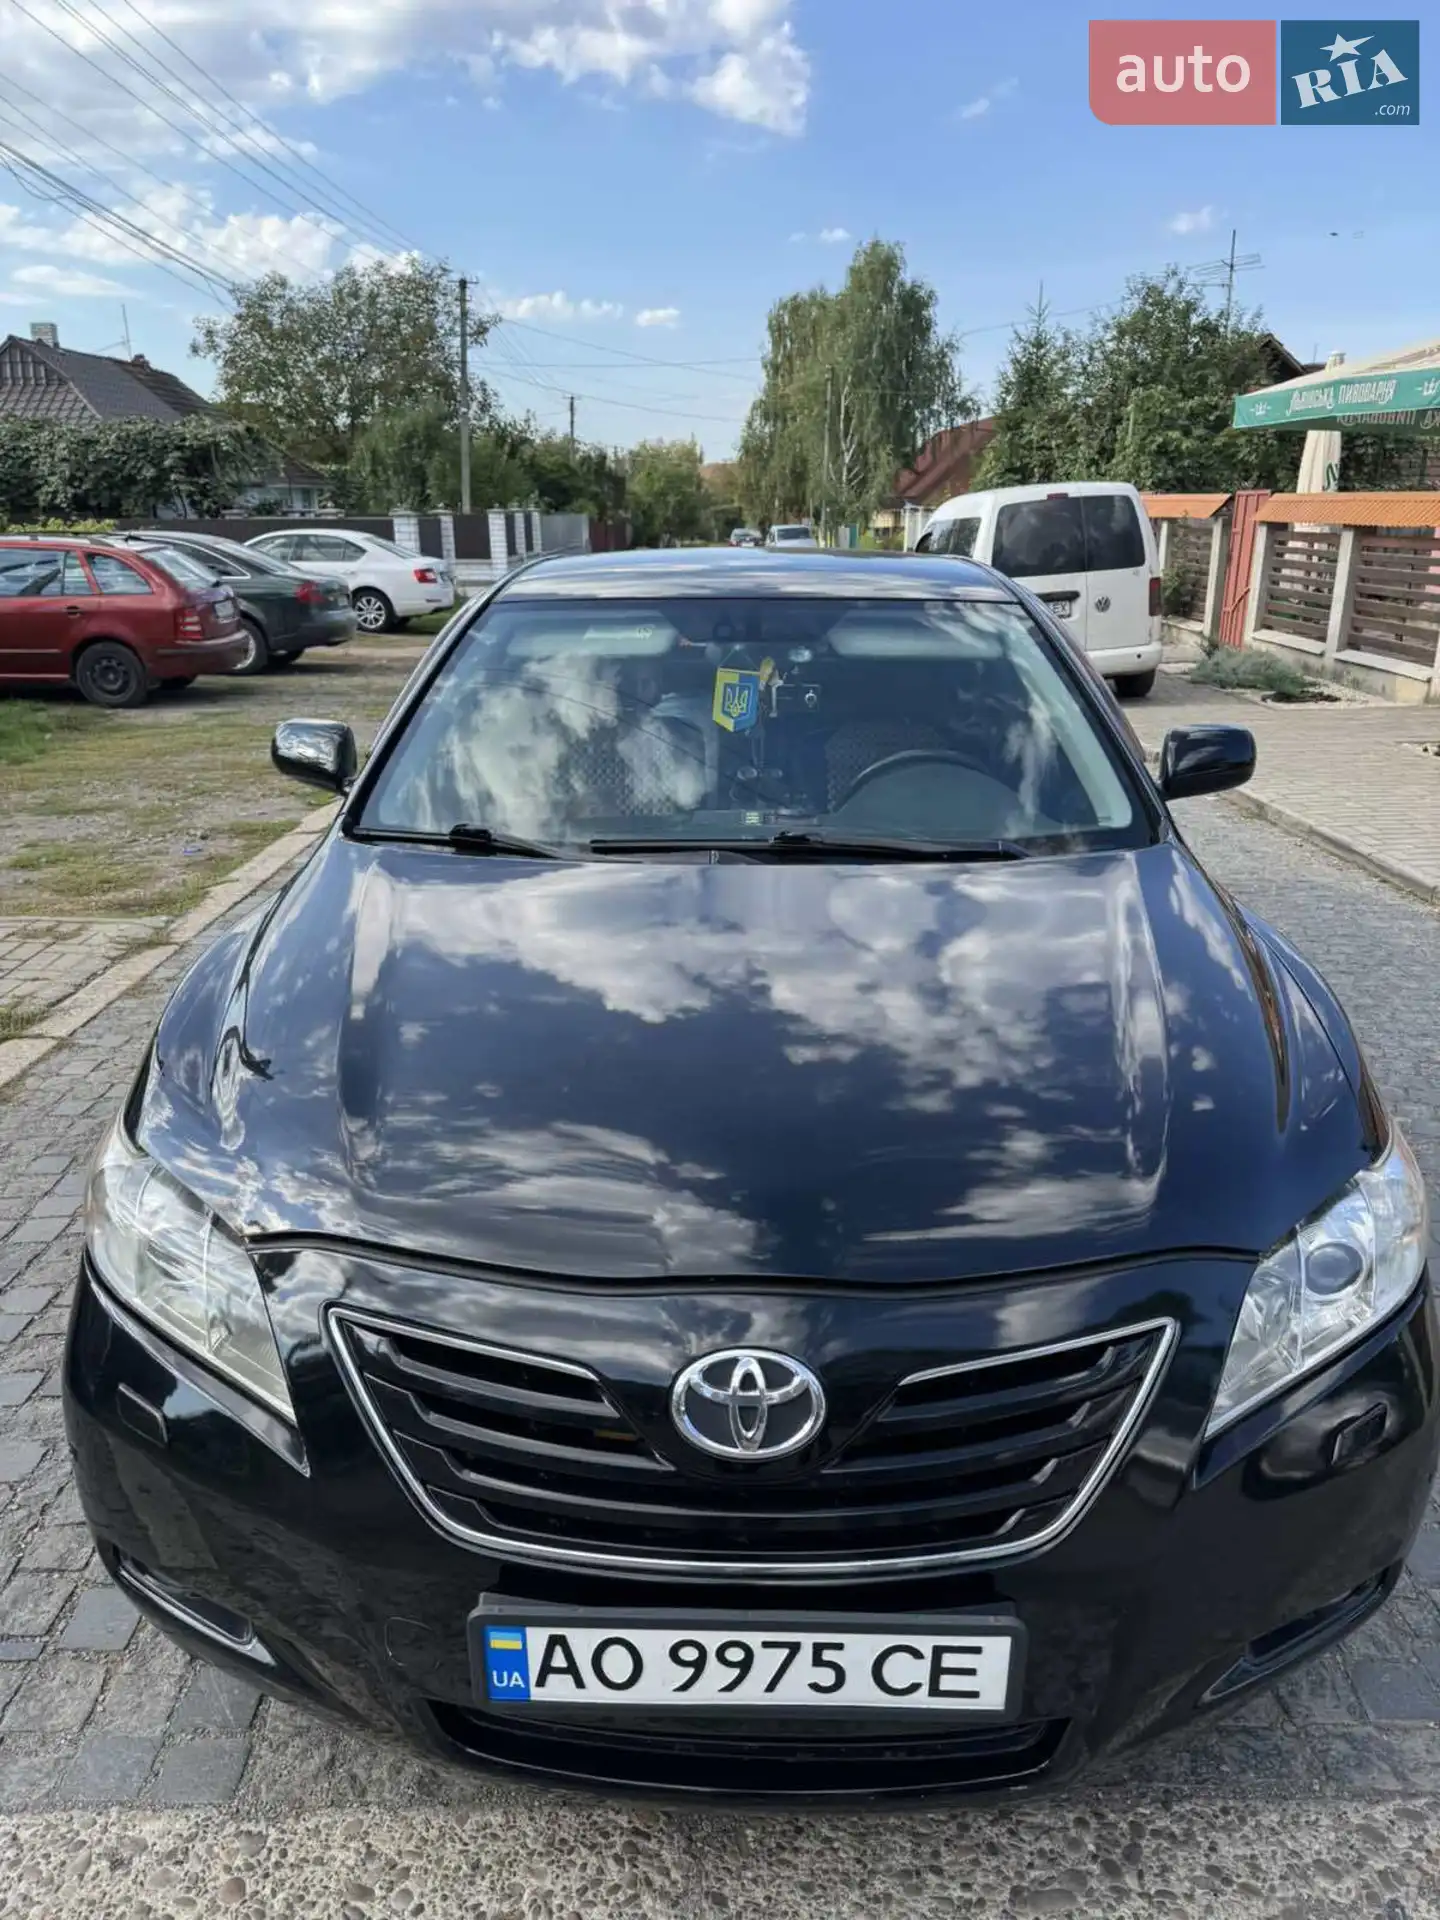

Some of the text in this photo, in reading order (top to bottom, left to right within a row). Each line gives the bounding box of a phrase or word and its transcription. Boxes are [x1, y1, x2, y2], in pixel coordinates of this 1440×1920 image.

[493, 1670, 525, 1689] UA
[535, 1633, 983, 1699] AO 9975 CE
